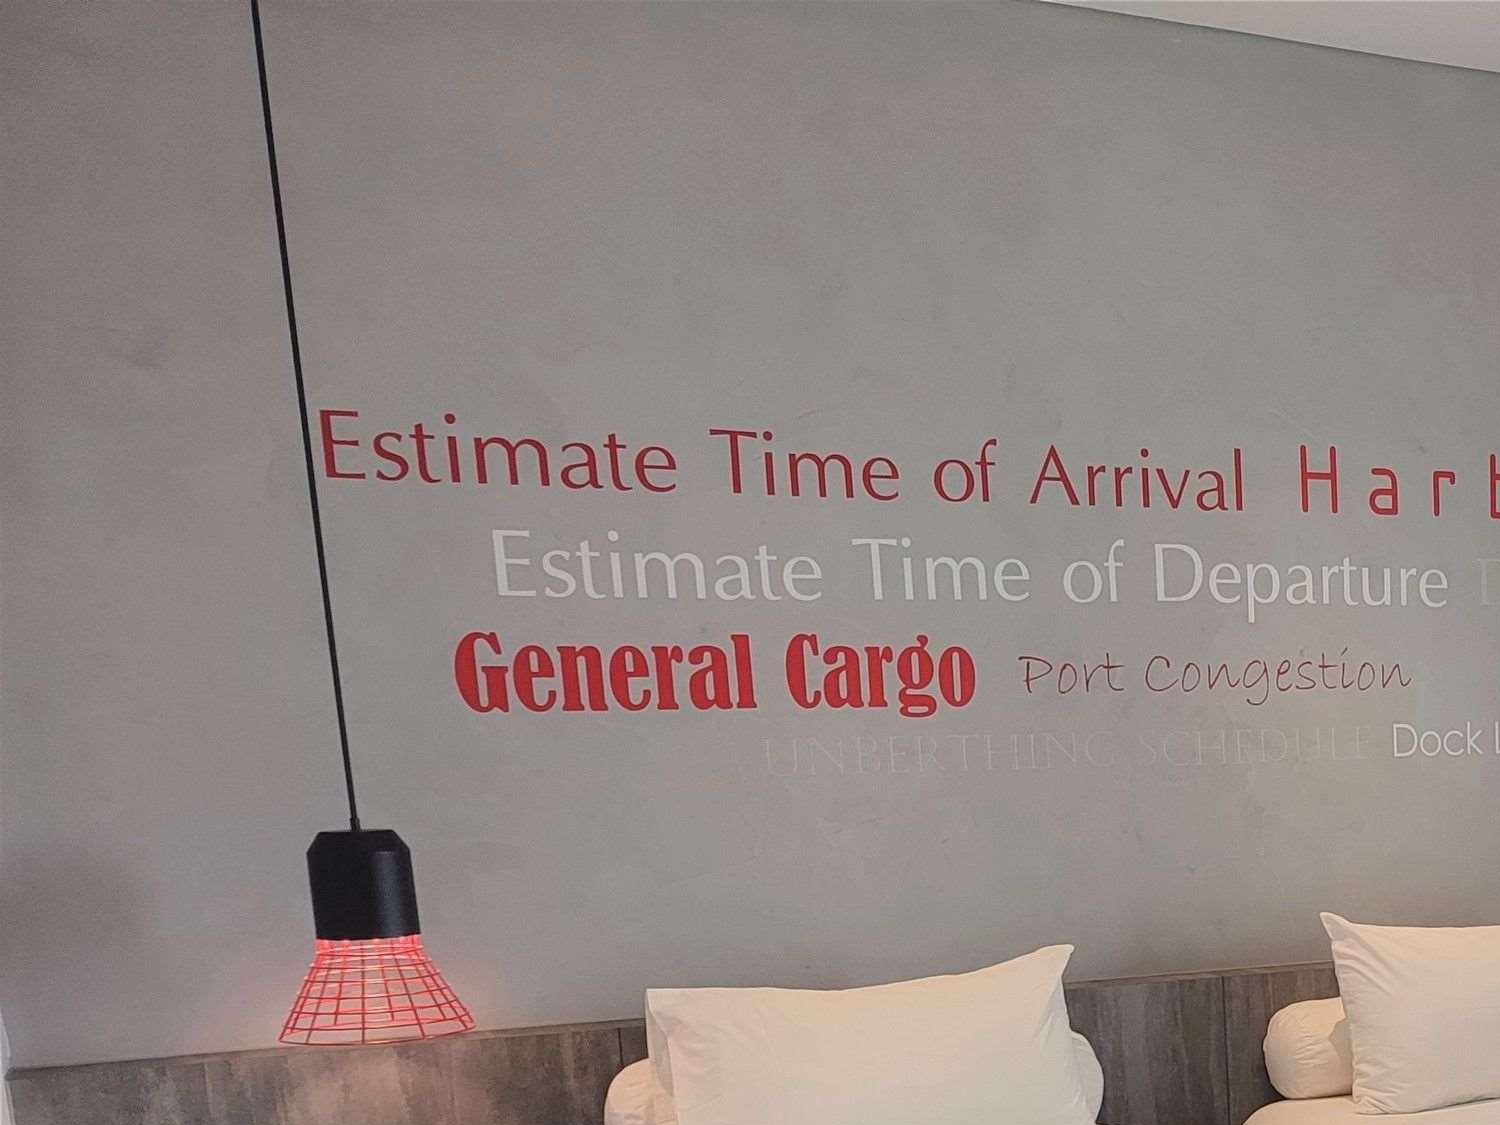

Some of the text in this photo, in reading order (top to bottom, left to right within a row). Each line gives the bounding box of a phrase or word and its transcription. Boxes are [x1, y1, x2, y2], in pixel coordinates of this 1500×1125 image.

[319, 409, 1243, 513] Estimate Time of Arrival
[491, 529, 1449, 624] Estimate Time of Departure
[454, 632, 976, 718] General Cargo
[1018, 647, 1412, 706] Port Congestion
[1392, 721, 1484, 757] Dock
